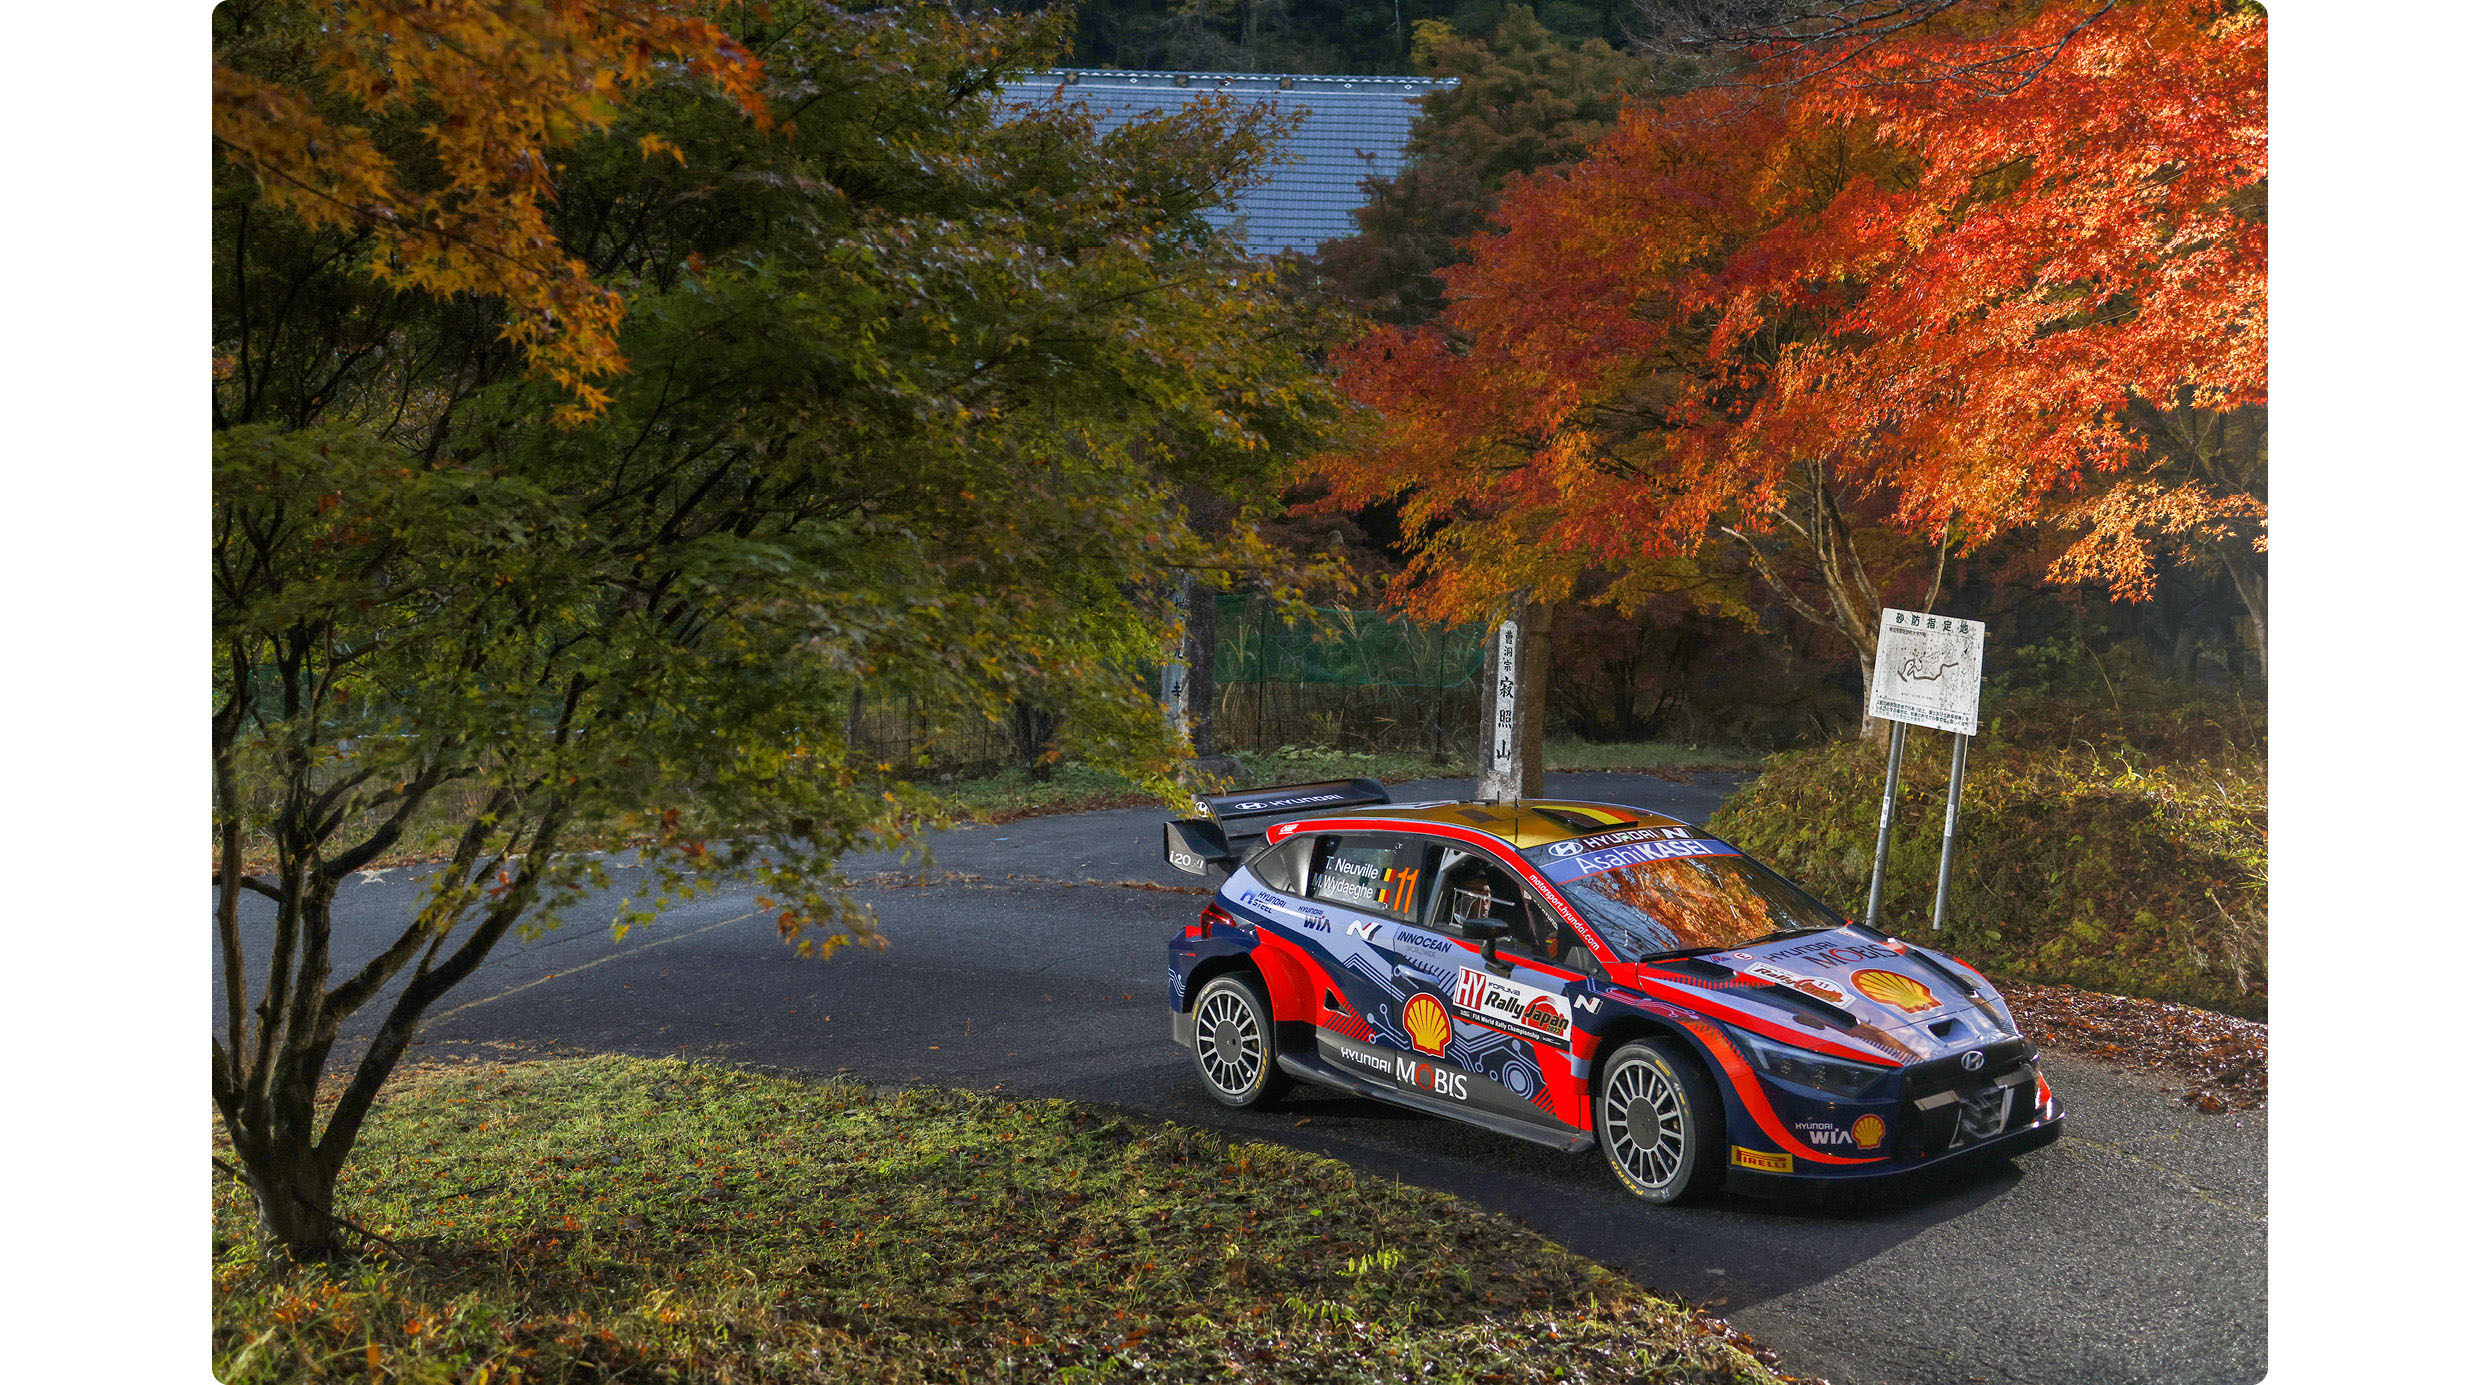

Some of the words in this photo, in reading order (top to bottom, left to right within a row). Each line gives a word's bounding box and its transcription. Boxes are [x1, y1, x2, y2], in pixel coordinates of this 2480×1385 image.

[1896, 613, 1969, 634] 砂防指定地
[1269, 794, 1344, 806] HYUNDAI
[1169, 850, 1191, 868] i20
[1325, 855, 1334, 869] T.
[1335, 858, 1379, 879] Neuville
[1257, 891, 1286, 907] HYUNDAI
[1393, 867, 1419, 914] 11
[1252, 899, 1272, 914] STEEL
[1298, 905, 1324, 915] HYUNDAI
[1529, 873, 1600, 951] motorsport.hyundai.com
[1397, 931, 1452, 953] INNOCEAN
[1763, 941, 1838, 962] HYUNDAI
[1754, 967, 1797, 985] Rally
[1818, 981, 1829, 989] 11
[1484, 990, 1525, 1019] Rally
[1524, 1003, 1569, 1030] Japan
[1472, 1013, 1481, 1021] FIA
[1481, 1016, 1494, 1025] World
[1495, 1020, 1507, 1029] Rally
[1507, 1024, 1540, 1040] Championship
[1340, 1046, 1391, 1074] HYUNDAI
[1396, 1056, 1468, 1100] MOBIS
[1736, 1150, 1787, 1168] PIRELLI
